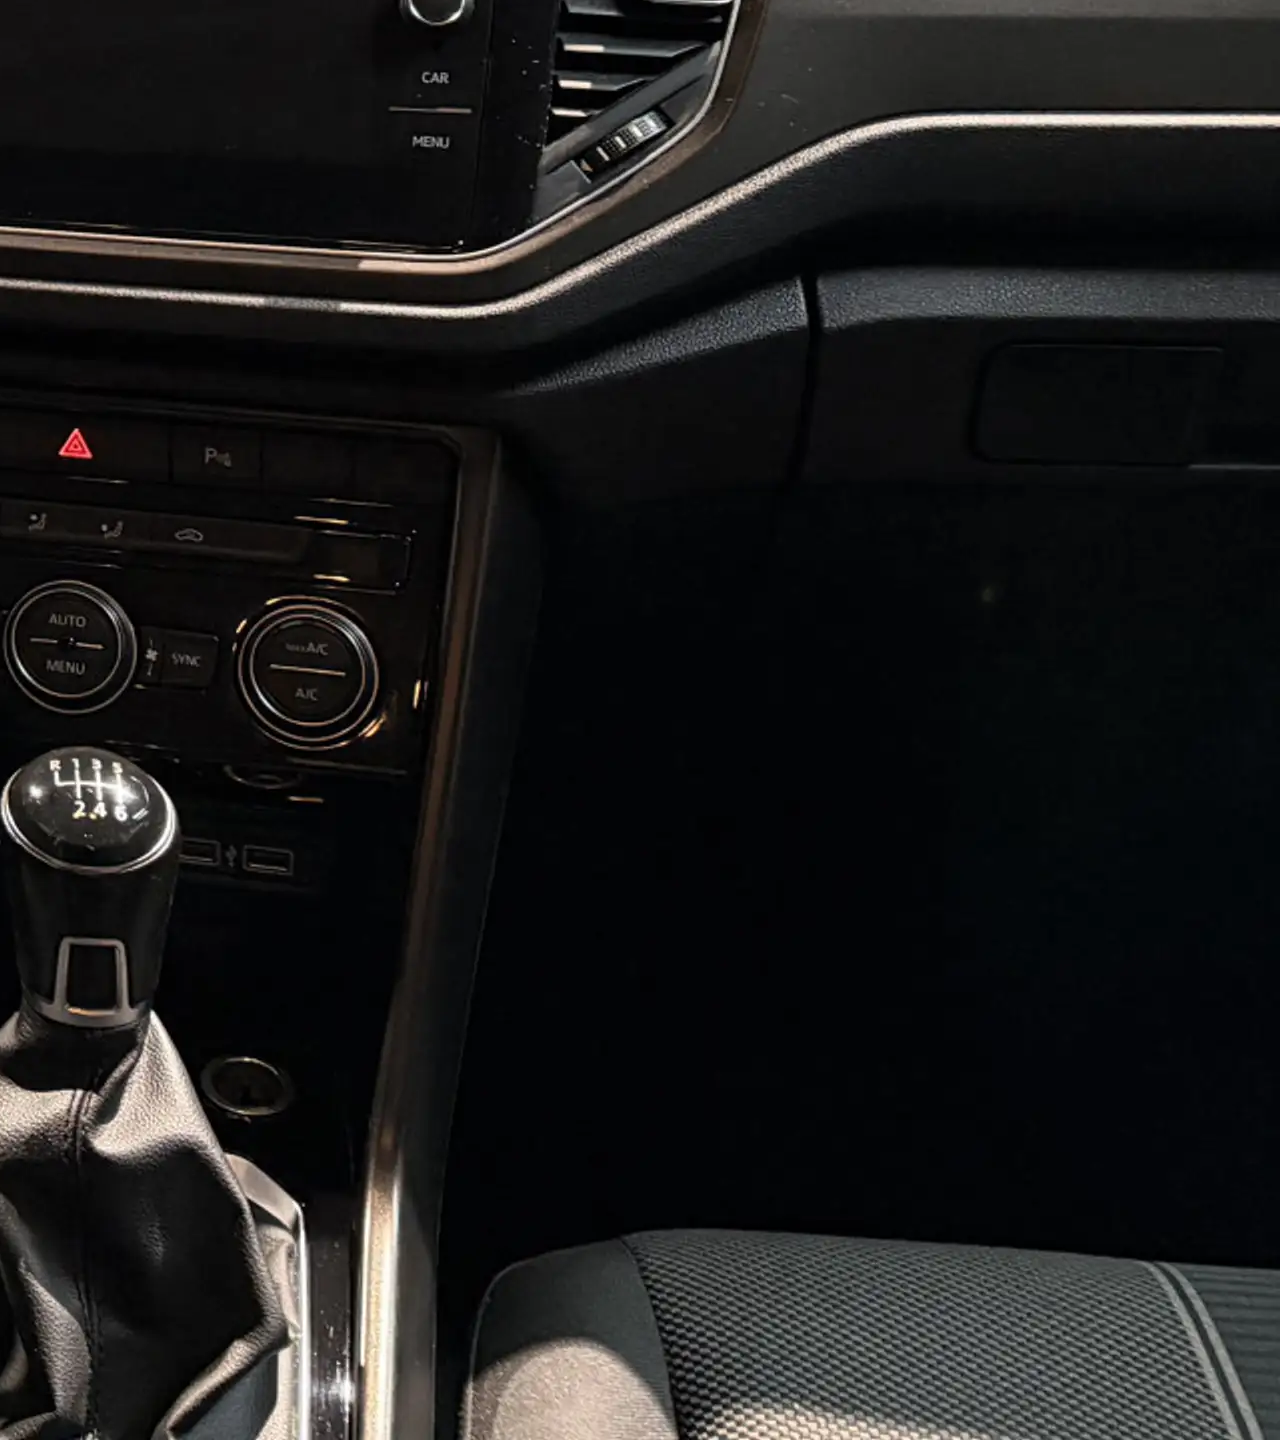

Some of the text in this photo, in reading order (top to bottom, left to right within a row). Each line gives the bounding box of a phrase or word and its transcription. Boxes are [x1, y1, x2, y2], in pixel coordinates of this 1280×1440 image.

[421, 71, 450, 85] CAR
[412, 136, 450, 149] MENU
[48, 613, 87, 628] AUTO
[46, 659, 86, 675] MENU
[50, 759, 61, 771] R
[72, 800, 128, 821] 2 4 6
